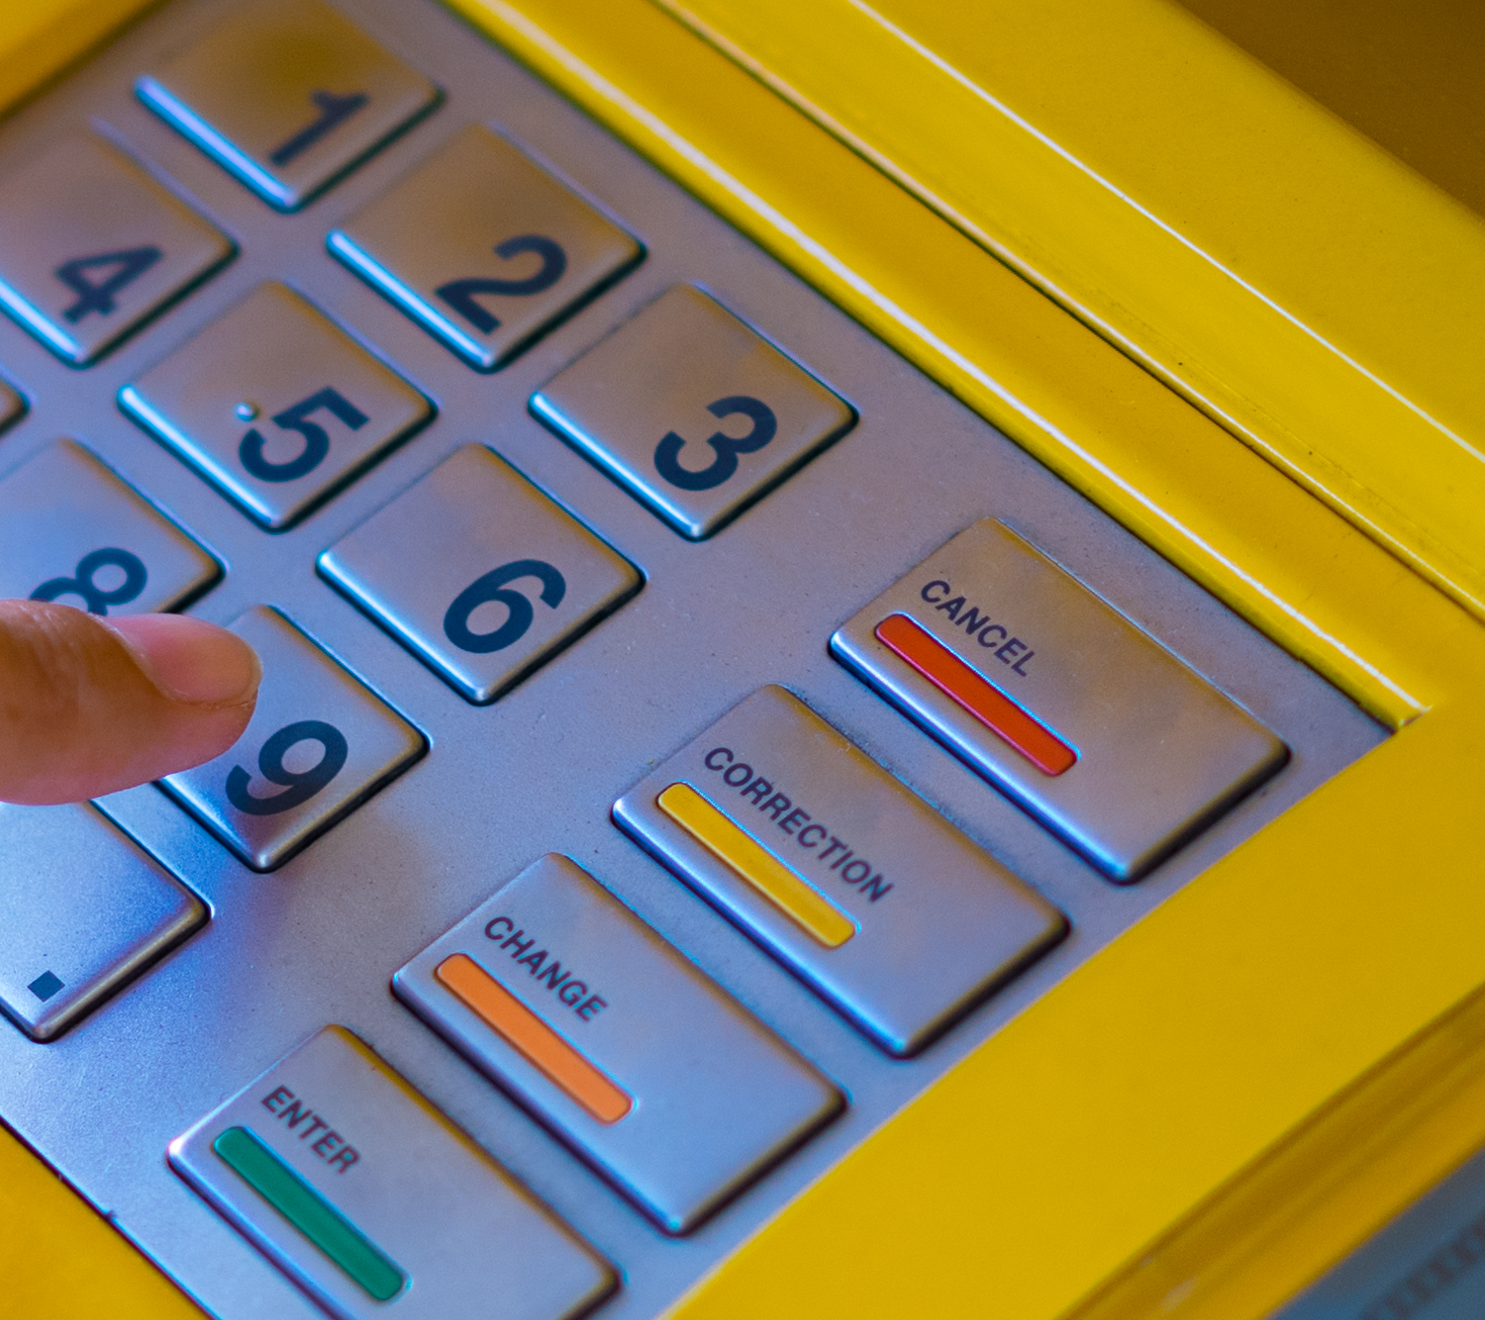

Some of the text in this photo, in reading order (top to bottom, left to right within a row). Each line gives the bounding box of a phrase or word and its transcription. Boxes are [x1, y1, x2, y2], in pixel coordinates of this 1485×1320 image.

[270, 87, 370, 168] 1
[53, 244, 162, 325] 4
[435, 235, 568, 335] 2
[238, 386, 371, 484] 5
[652, 395, 779, 492] 3
[29, 547, 148, 616] 8
[442, 558, 567, 655] 6
[920, 578, 1039, 678] CANCEL
[225, 719, 348, 816] 9
[703, 746, 895, 903] CORRECTION
[483, 914, 609, 1024] CHANGE
[261, 1085, 362, 1176] ENTER
